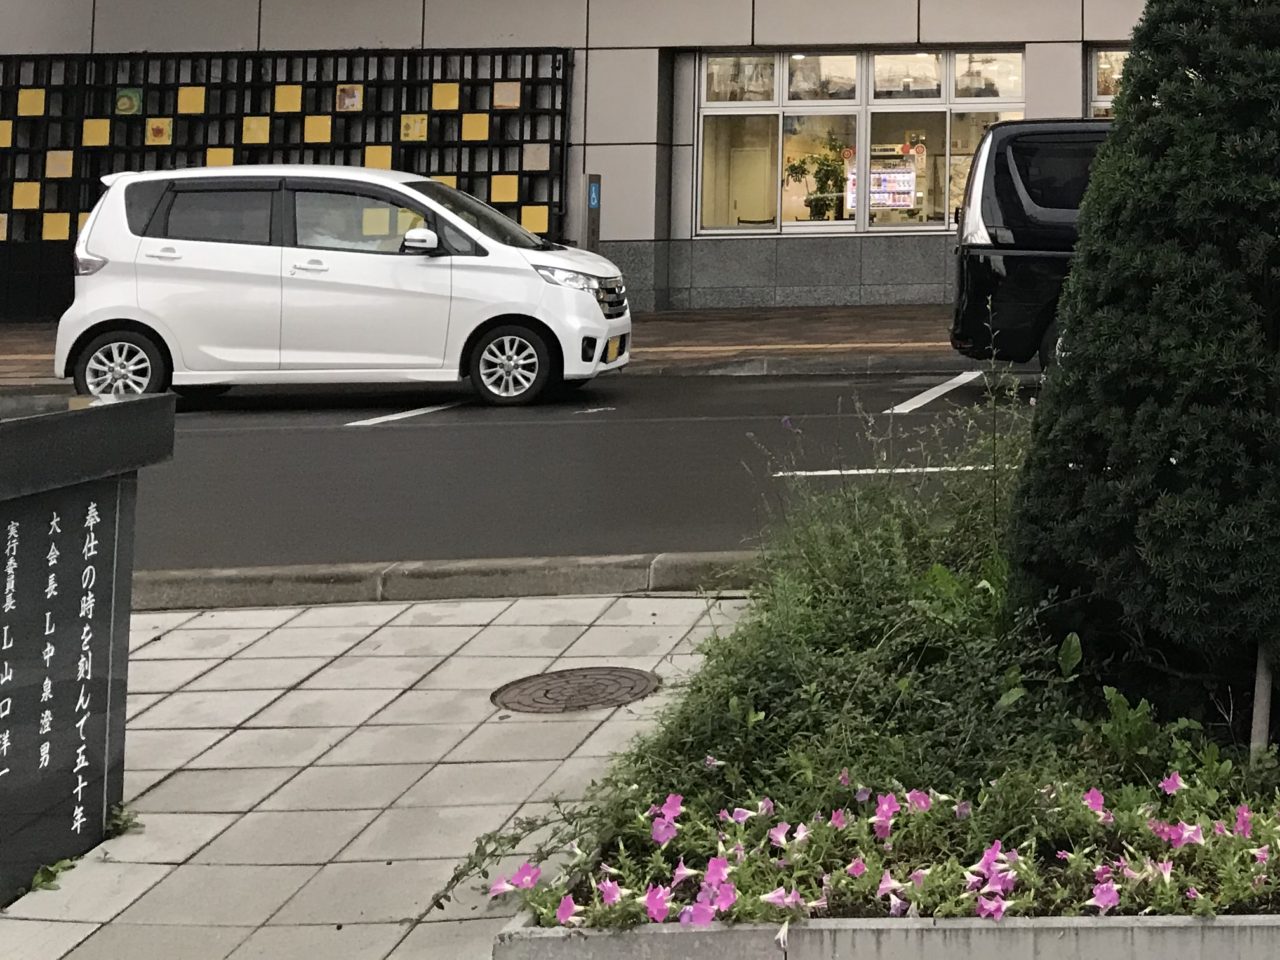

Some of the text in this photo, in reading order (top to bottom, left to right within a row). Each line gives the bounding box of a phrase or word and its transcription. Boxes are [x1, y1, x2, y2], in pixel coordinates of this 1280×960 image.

[70, 501, 101, 835] 奉仕の時を刻んで五十年
